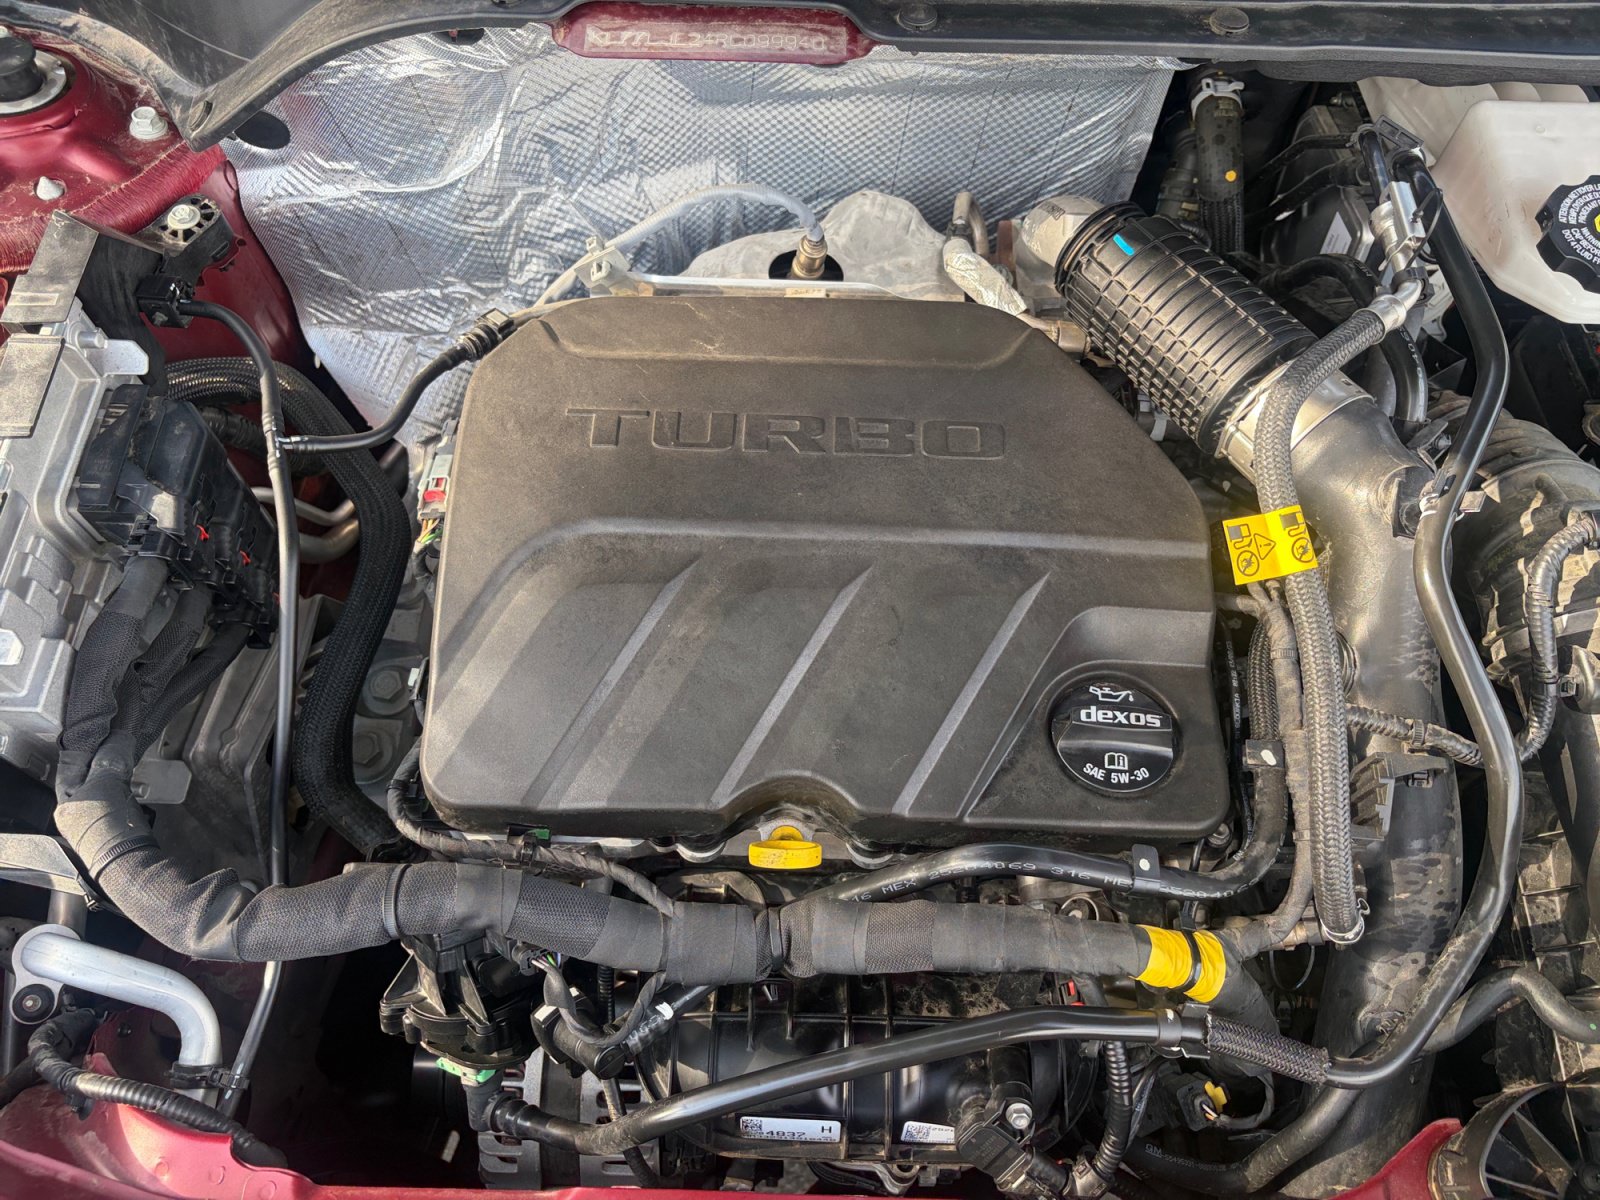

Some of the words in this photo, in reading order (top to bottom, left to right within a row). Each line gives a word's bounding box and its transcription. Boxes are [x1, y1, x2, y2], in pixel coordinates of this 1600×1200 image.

[1561, 229, 1575, 242] DOT
[1573, 244, 1593, 261] FLUID
[1571, 228, 1584, 240] CAP
[565, 408, 1006, 461] TURBO
[1079, 705, 1163, 728] dexos
[1083, 763, 1106, 781] SAE
[1110, 767, 1150, 784] 5W-30
[881, 878, 918, 895] MEX
[1050, 866, 1092, 880] 316
[1103, 876, 1133, 888] ME
[821, 1125, 832, 1134] H
